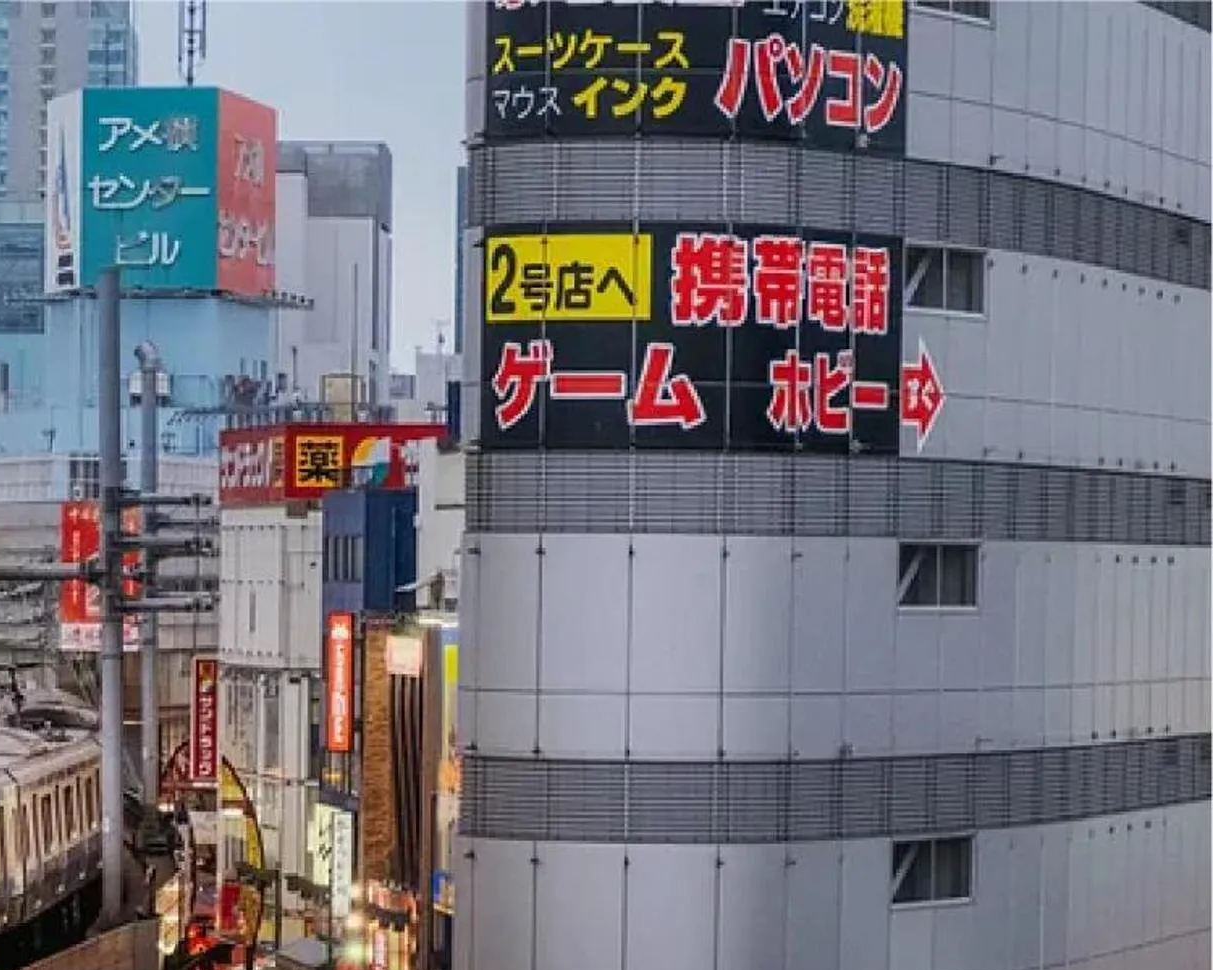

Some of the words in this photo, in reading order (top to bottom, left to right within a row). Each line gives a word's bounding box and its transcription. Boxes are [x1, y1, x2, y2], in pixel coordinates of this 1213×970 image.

[492, 29, 689, 74] スーツケース
[714, 33, 901, 133] パソコン
[492, 86, 562, 118] マウス
[571, 76, 688, 119] インク
[491, 243, 638, 315] 2号店へ
[670, 232, 890, 336] 携帯電話
[493, 339, 707, 430] ゲーム
[766, 348, 889, 434] ホビー
